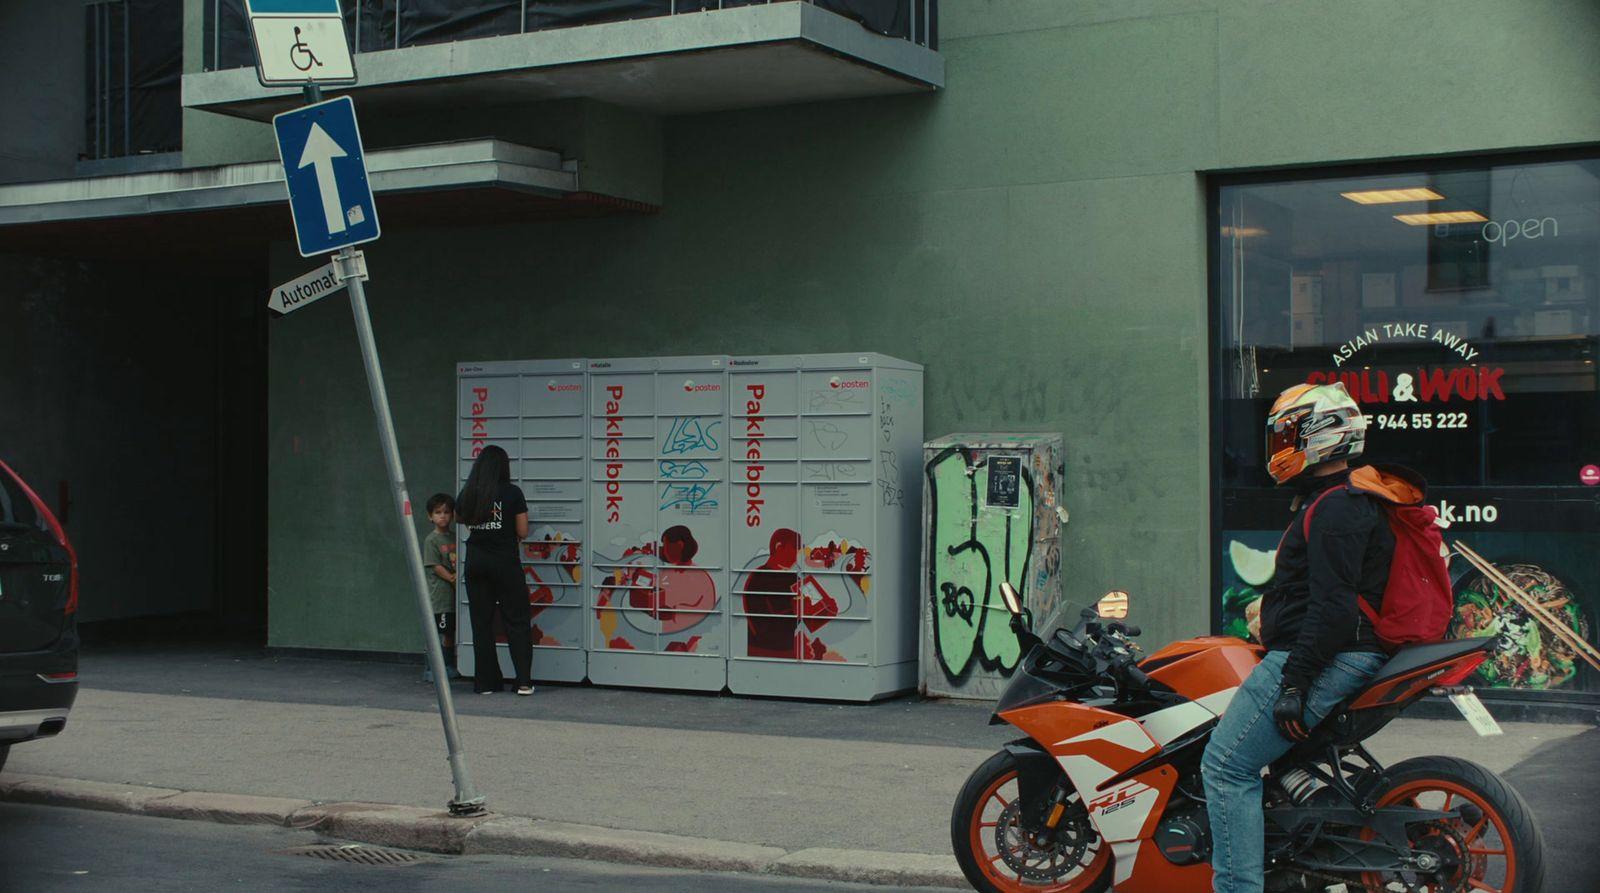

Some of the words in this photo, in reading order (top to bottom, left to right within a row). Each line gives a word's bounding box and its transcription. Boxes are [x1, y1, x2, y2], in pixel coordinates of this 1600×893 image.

[1482, 217, 1557, 247] open
[280, 269, 338, 308] Automat
[1332, 328, 1379, 367] ASIAN
[1383, 323, 1429, 339] TAKE
[1431, 328, 1479, 361] AWAY
[841, 379, 869, 390] posten
[1392, 372, 1418, 402] &
[1419, 365, 1506, 404] WOK
[472, 387, 488, 458] Pakke
[1377, 414, 1407, 430] 944
[1412, 414, 1433, 429] 55
[1437, 412, 1468, 429] 222
[606, 385, 624, 524] Pakkeboks
[746, 384, 765, 528] Pakkeboks
[940, 581, 975, 628] BQ
[1101, 797, 1136, 816] 125
